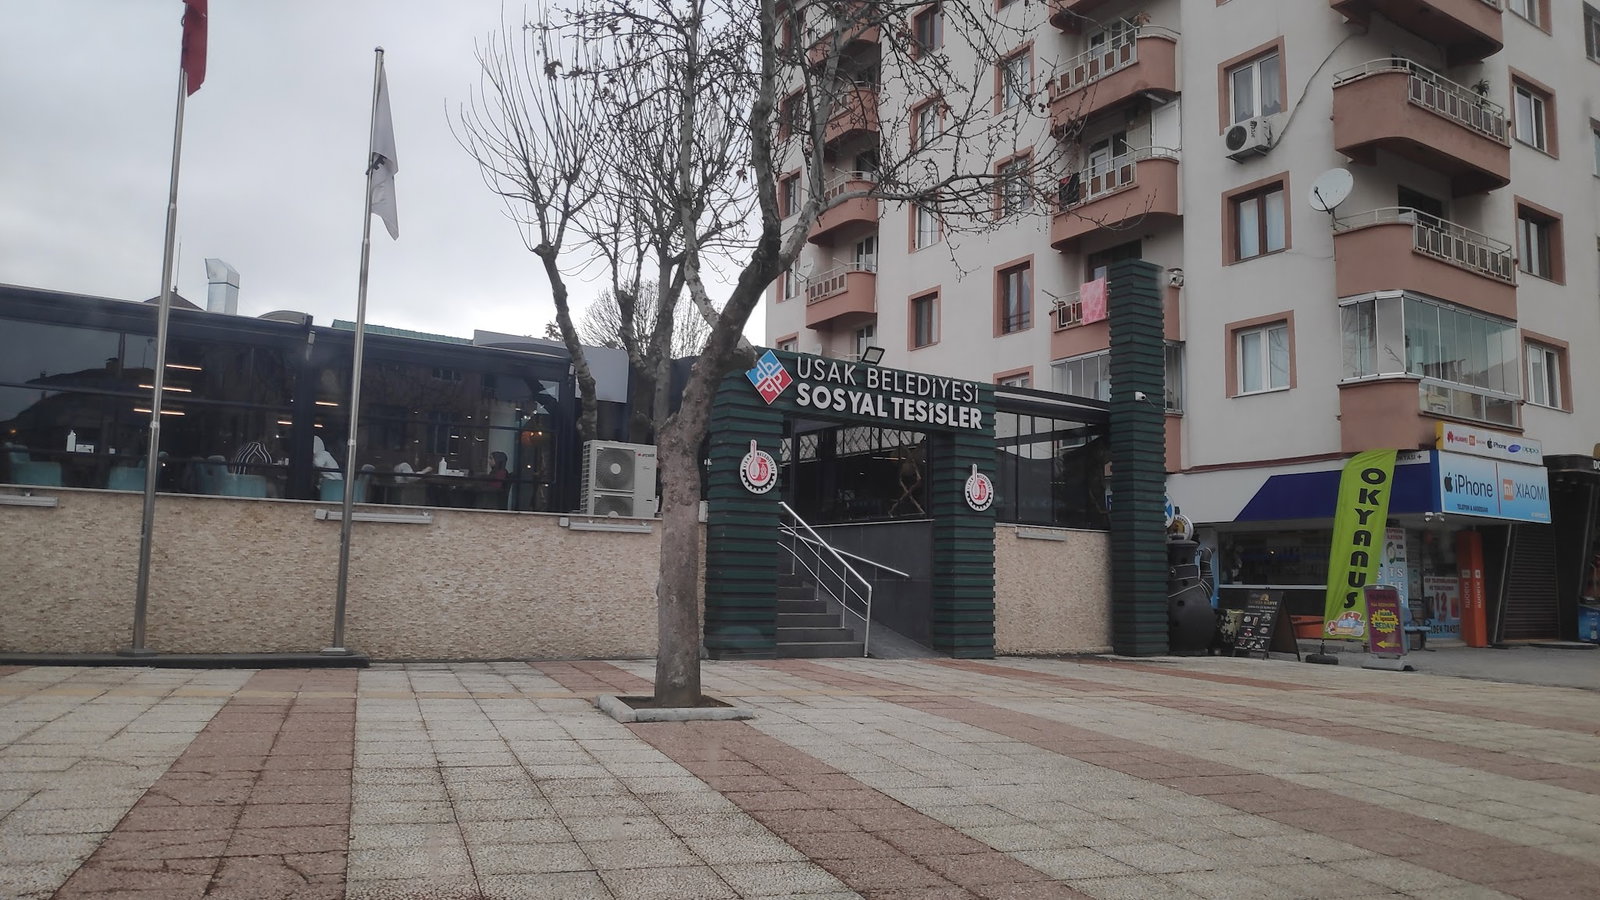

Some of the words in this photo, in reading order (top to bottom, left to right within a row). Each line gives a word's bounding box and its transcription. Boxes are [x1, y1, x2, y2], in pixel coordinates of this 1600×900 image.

[796, 382, 888, 418] SOSYAL
[890, 396, 983, 430] TESİSLER
[1455, 474, 1493, 498] iPhone
[1515, 483, 1547, 501] XIAOMI
[1343, 467, 1387, 609] OKYANUS
